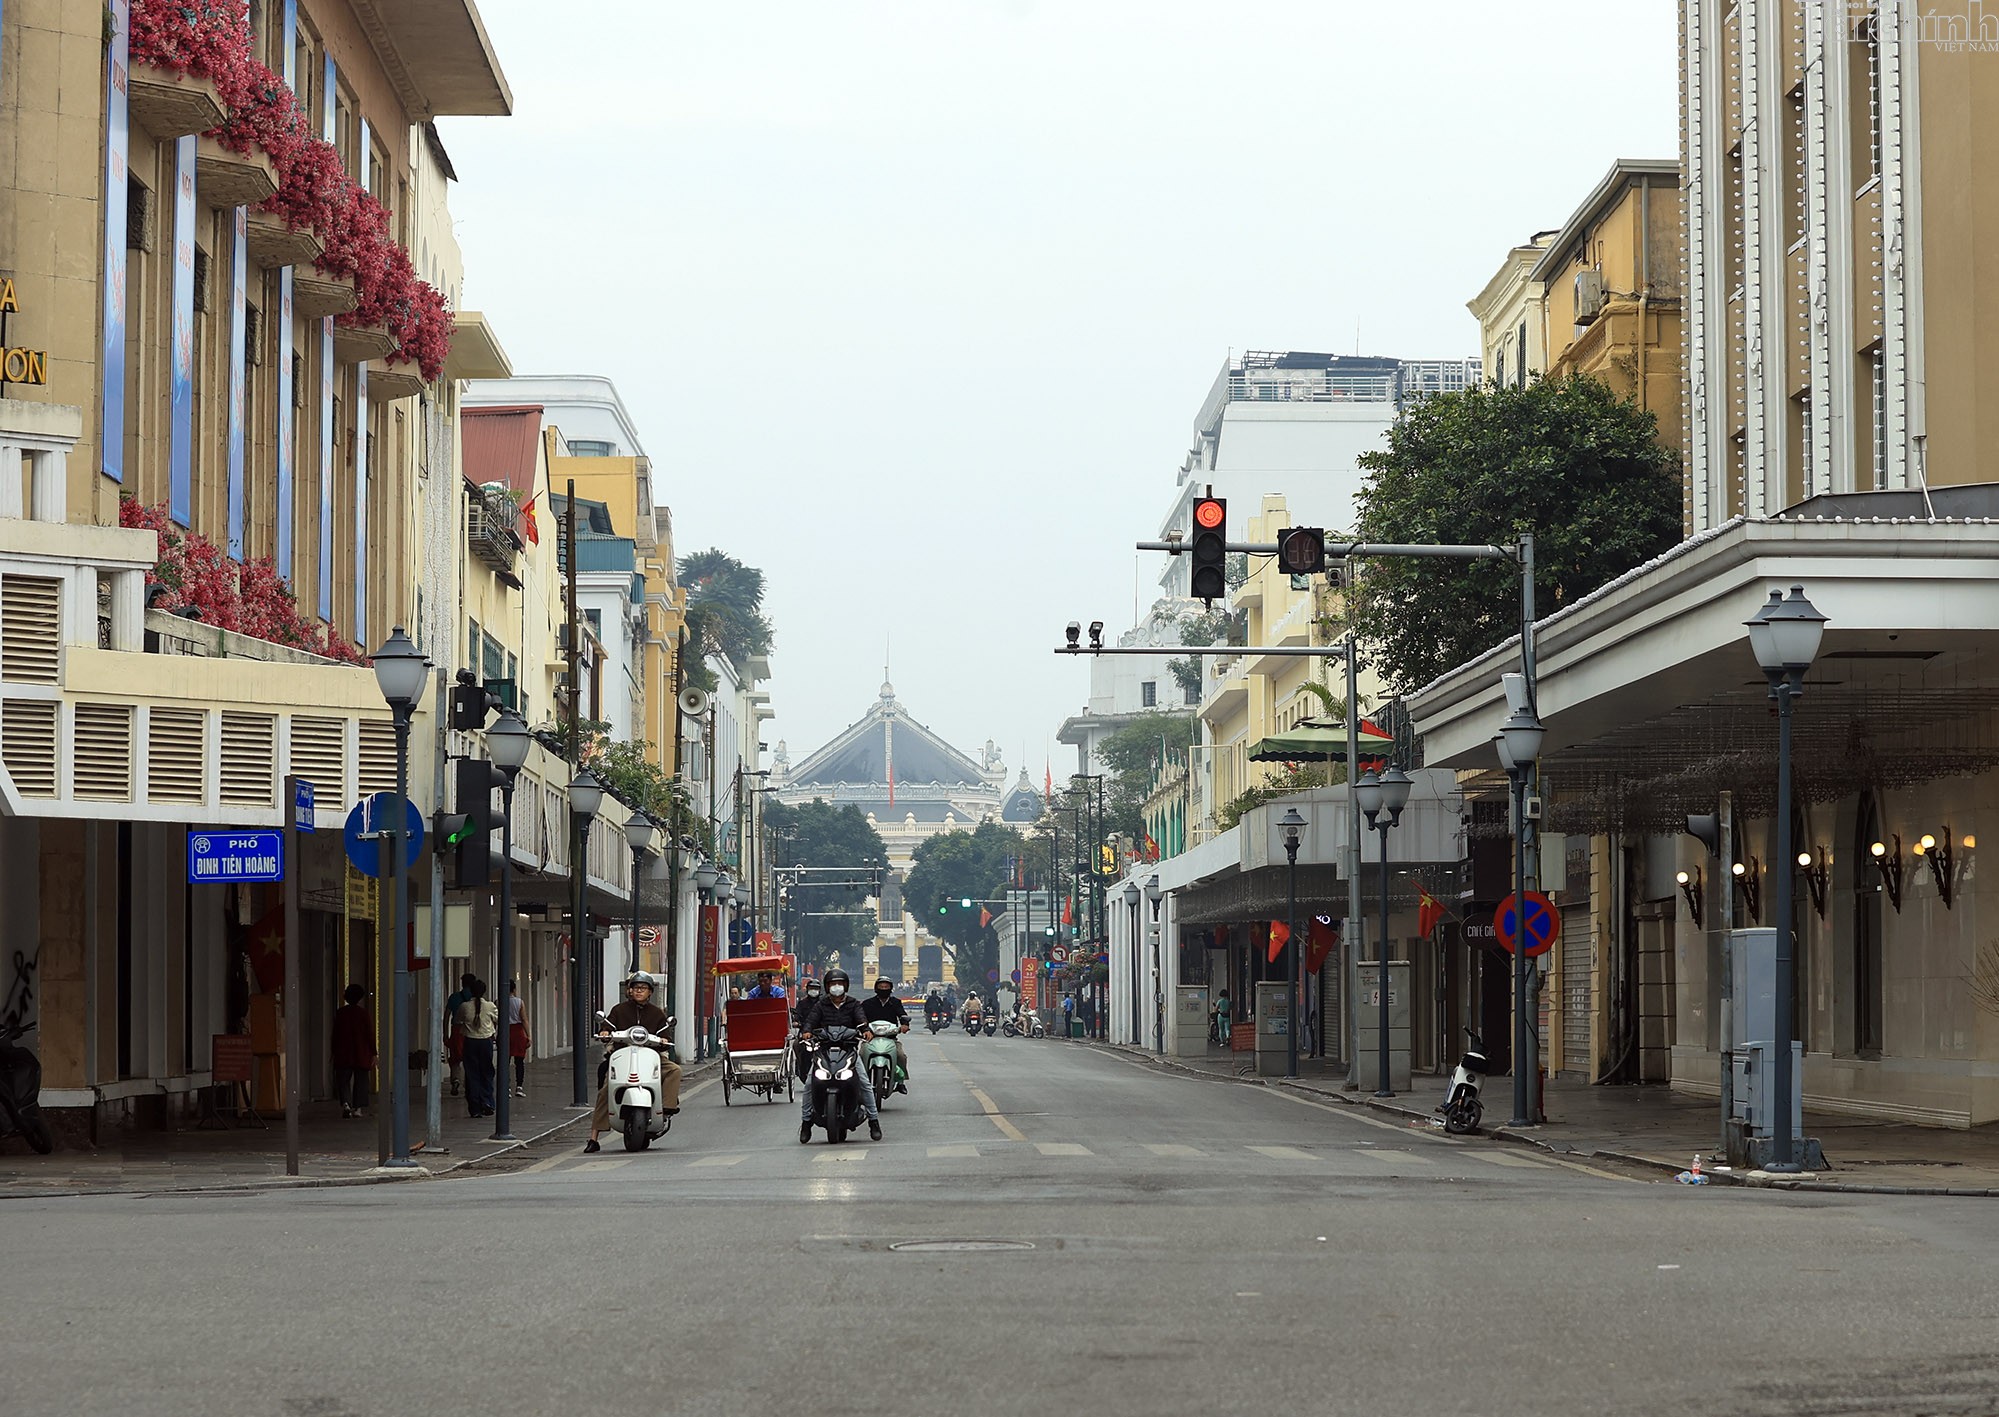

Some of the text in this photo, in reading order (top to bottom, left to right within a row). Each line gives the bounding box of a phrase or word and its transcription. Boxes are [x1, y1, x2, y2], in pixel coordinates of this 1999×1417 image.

[229, 835, 258, 849] PHỐ
[196, 854, 276, 875] ĐINH TIÊN HOÀNG
